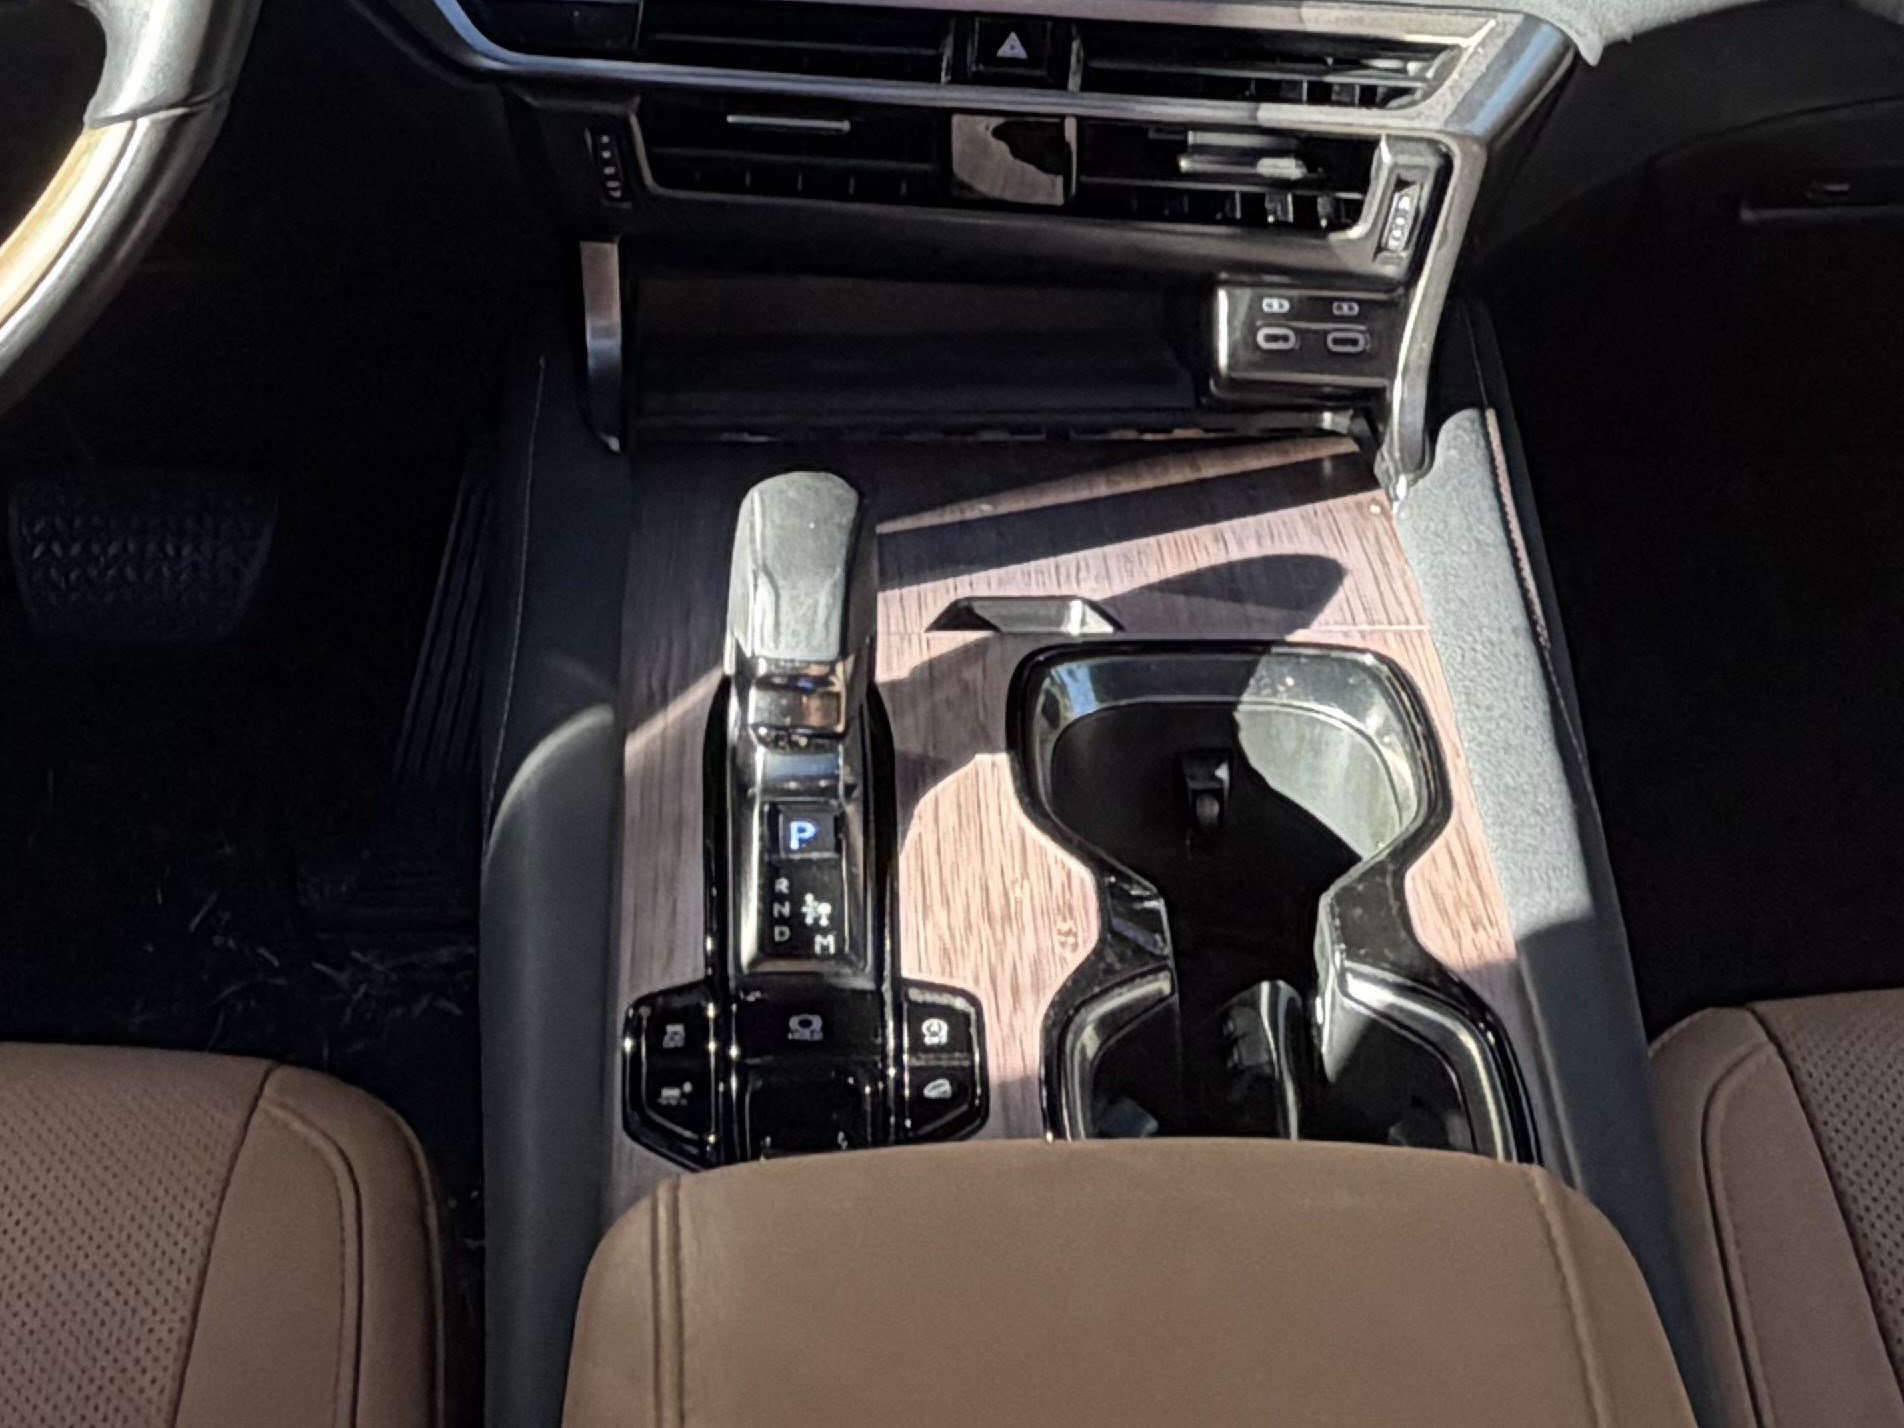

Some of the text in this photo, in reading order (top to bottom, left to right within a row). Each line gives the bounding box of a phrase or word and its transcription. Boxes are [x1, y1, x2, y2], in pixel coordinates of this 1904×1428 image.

[790, 820, 816, 850] P
[774, 876, 790, 894] R
[772, 900, 791, 918] N
[774, 925, 791, 942] D
[814, 933, 836, 955] M
